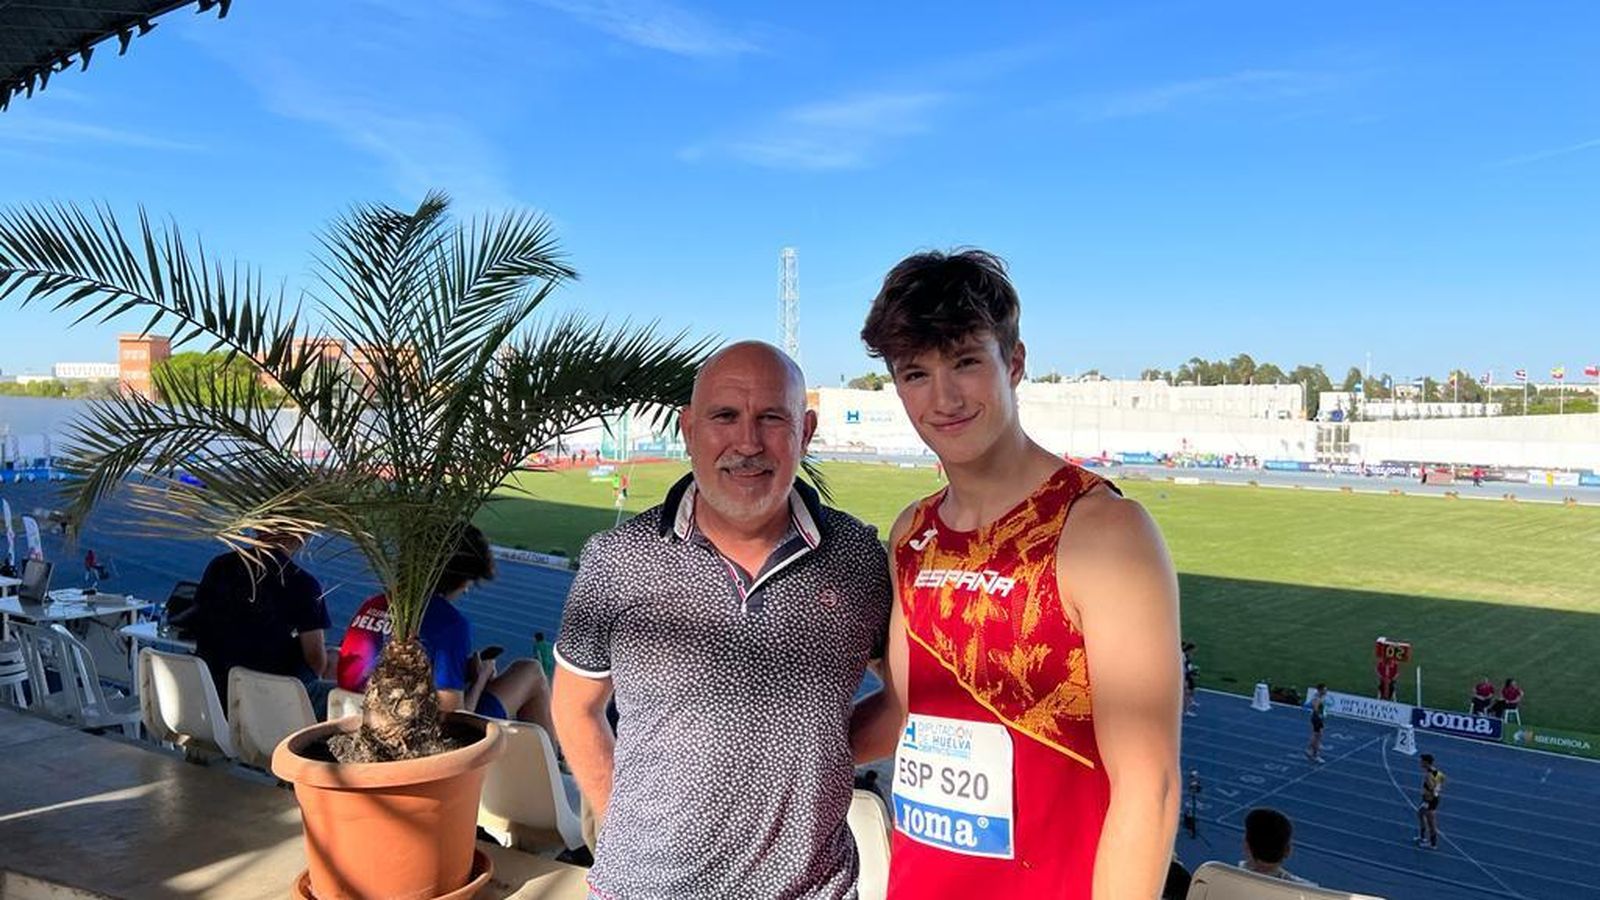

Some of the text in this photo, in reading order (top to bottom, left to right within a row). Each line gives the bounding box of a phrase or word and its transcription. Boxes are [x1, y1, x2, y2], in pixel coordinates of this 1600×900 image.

[914, 569, 1015, 597] ESPAÑA
[933, 735, 971, 750] HUELVA
[1399, 732, 1408, 746] 2
[1534, 735, 1591, 749] IBERDROLA
[900, 756, 989, 801] ESP S20
